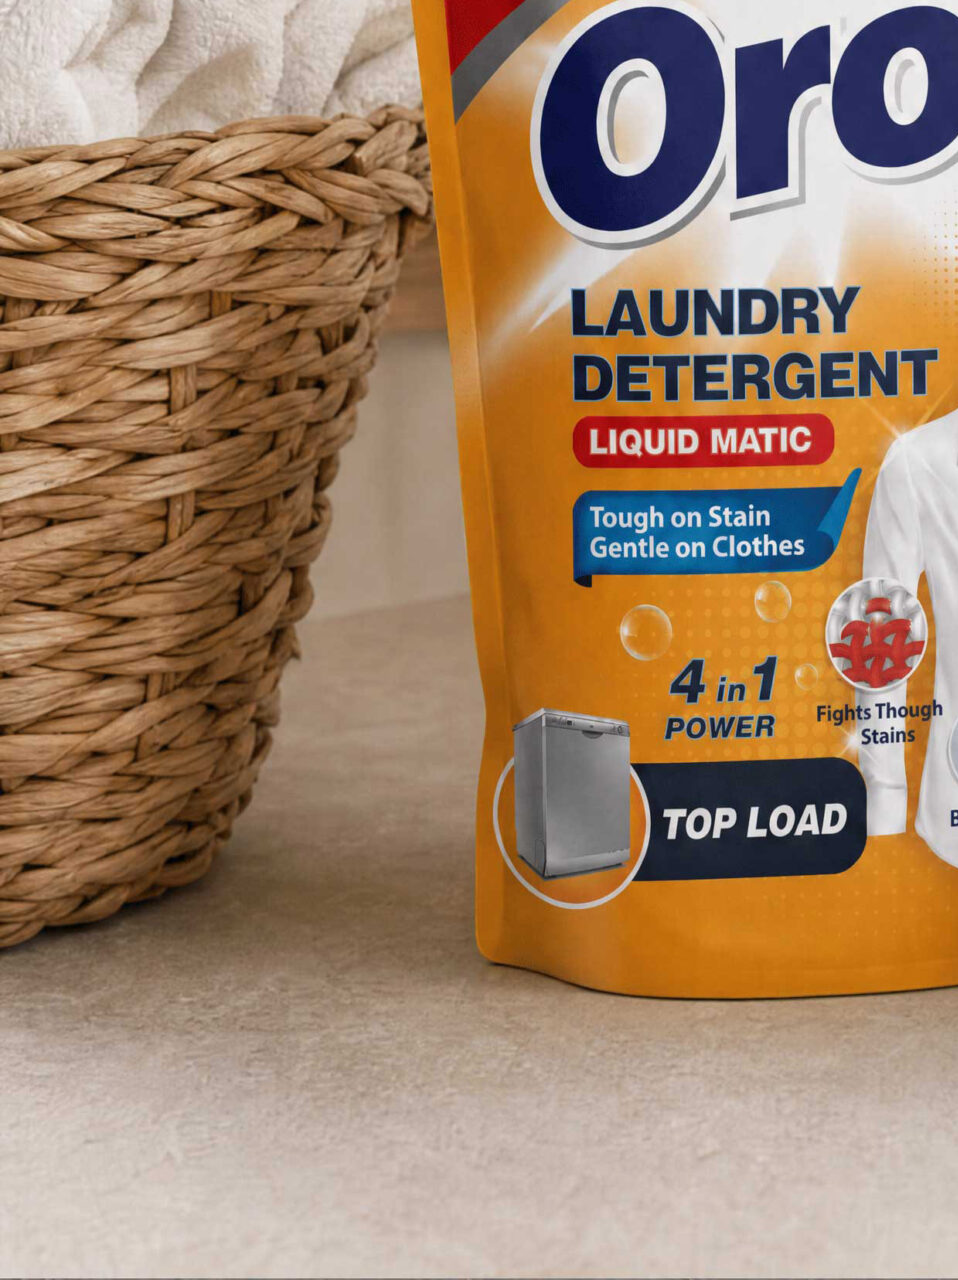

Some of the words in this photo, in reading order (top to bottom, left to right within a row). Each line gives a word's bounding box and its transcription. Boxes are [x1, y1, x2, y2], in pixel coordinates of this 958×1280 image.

[571, 286, 861, 337] LAUNDRY
[573, 349, 939, 402] DETERGENT
[589, 428, 700, 458] LIQUID
[710, 426, 812, 455] MATIC
[590, 505, 664, 533] Tough
[671, 510, 702, 528] on
[708, 504, 771, 527] Stain
[590, 536, 670, 558] Gentle
[675, 540, 706, 558] on
[712, 534, 805, 556] Clothes
[669, 658, 707, 704] 4
[716, 676, 747, 702] in
[752, 655, 778, 701] 1
[664, 715, 776, 739] POWER
[816, 704, 872, 726] Fights
[875, 700, 943, 722] Though
[861, 727, 916, 745] Stains
[663, 807, 737, 839] TOP
[746, 803, 848, 838] LOAD
